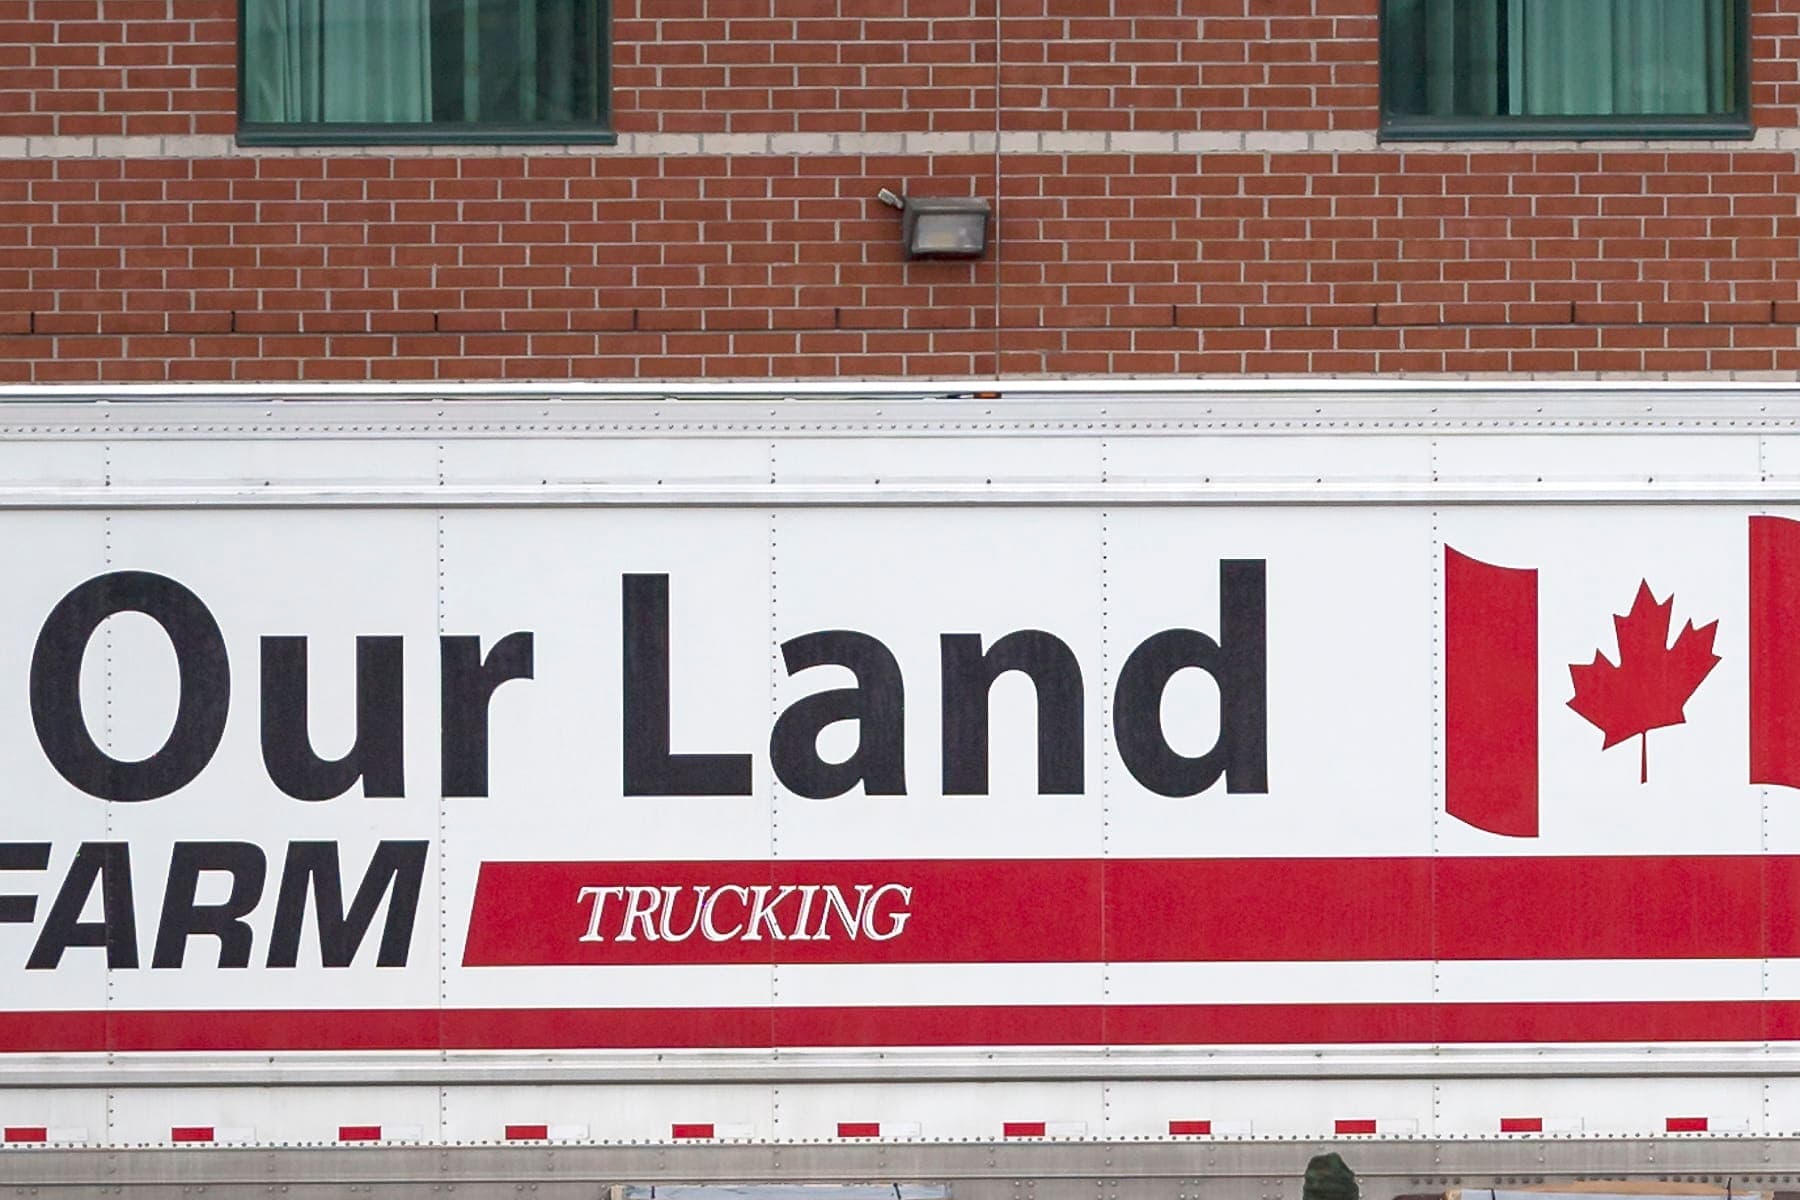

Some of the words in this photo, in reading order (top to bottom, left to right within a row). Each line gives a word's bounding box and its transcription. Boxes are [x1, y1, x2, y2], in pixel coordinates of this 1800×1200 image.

[29, 569, 535, 803] Our
[621, 557, 1270, 800] Land
[576, 884, 914, 943] TRUCKING
